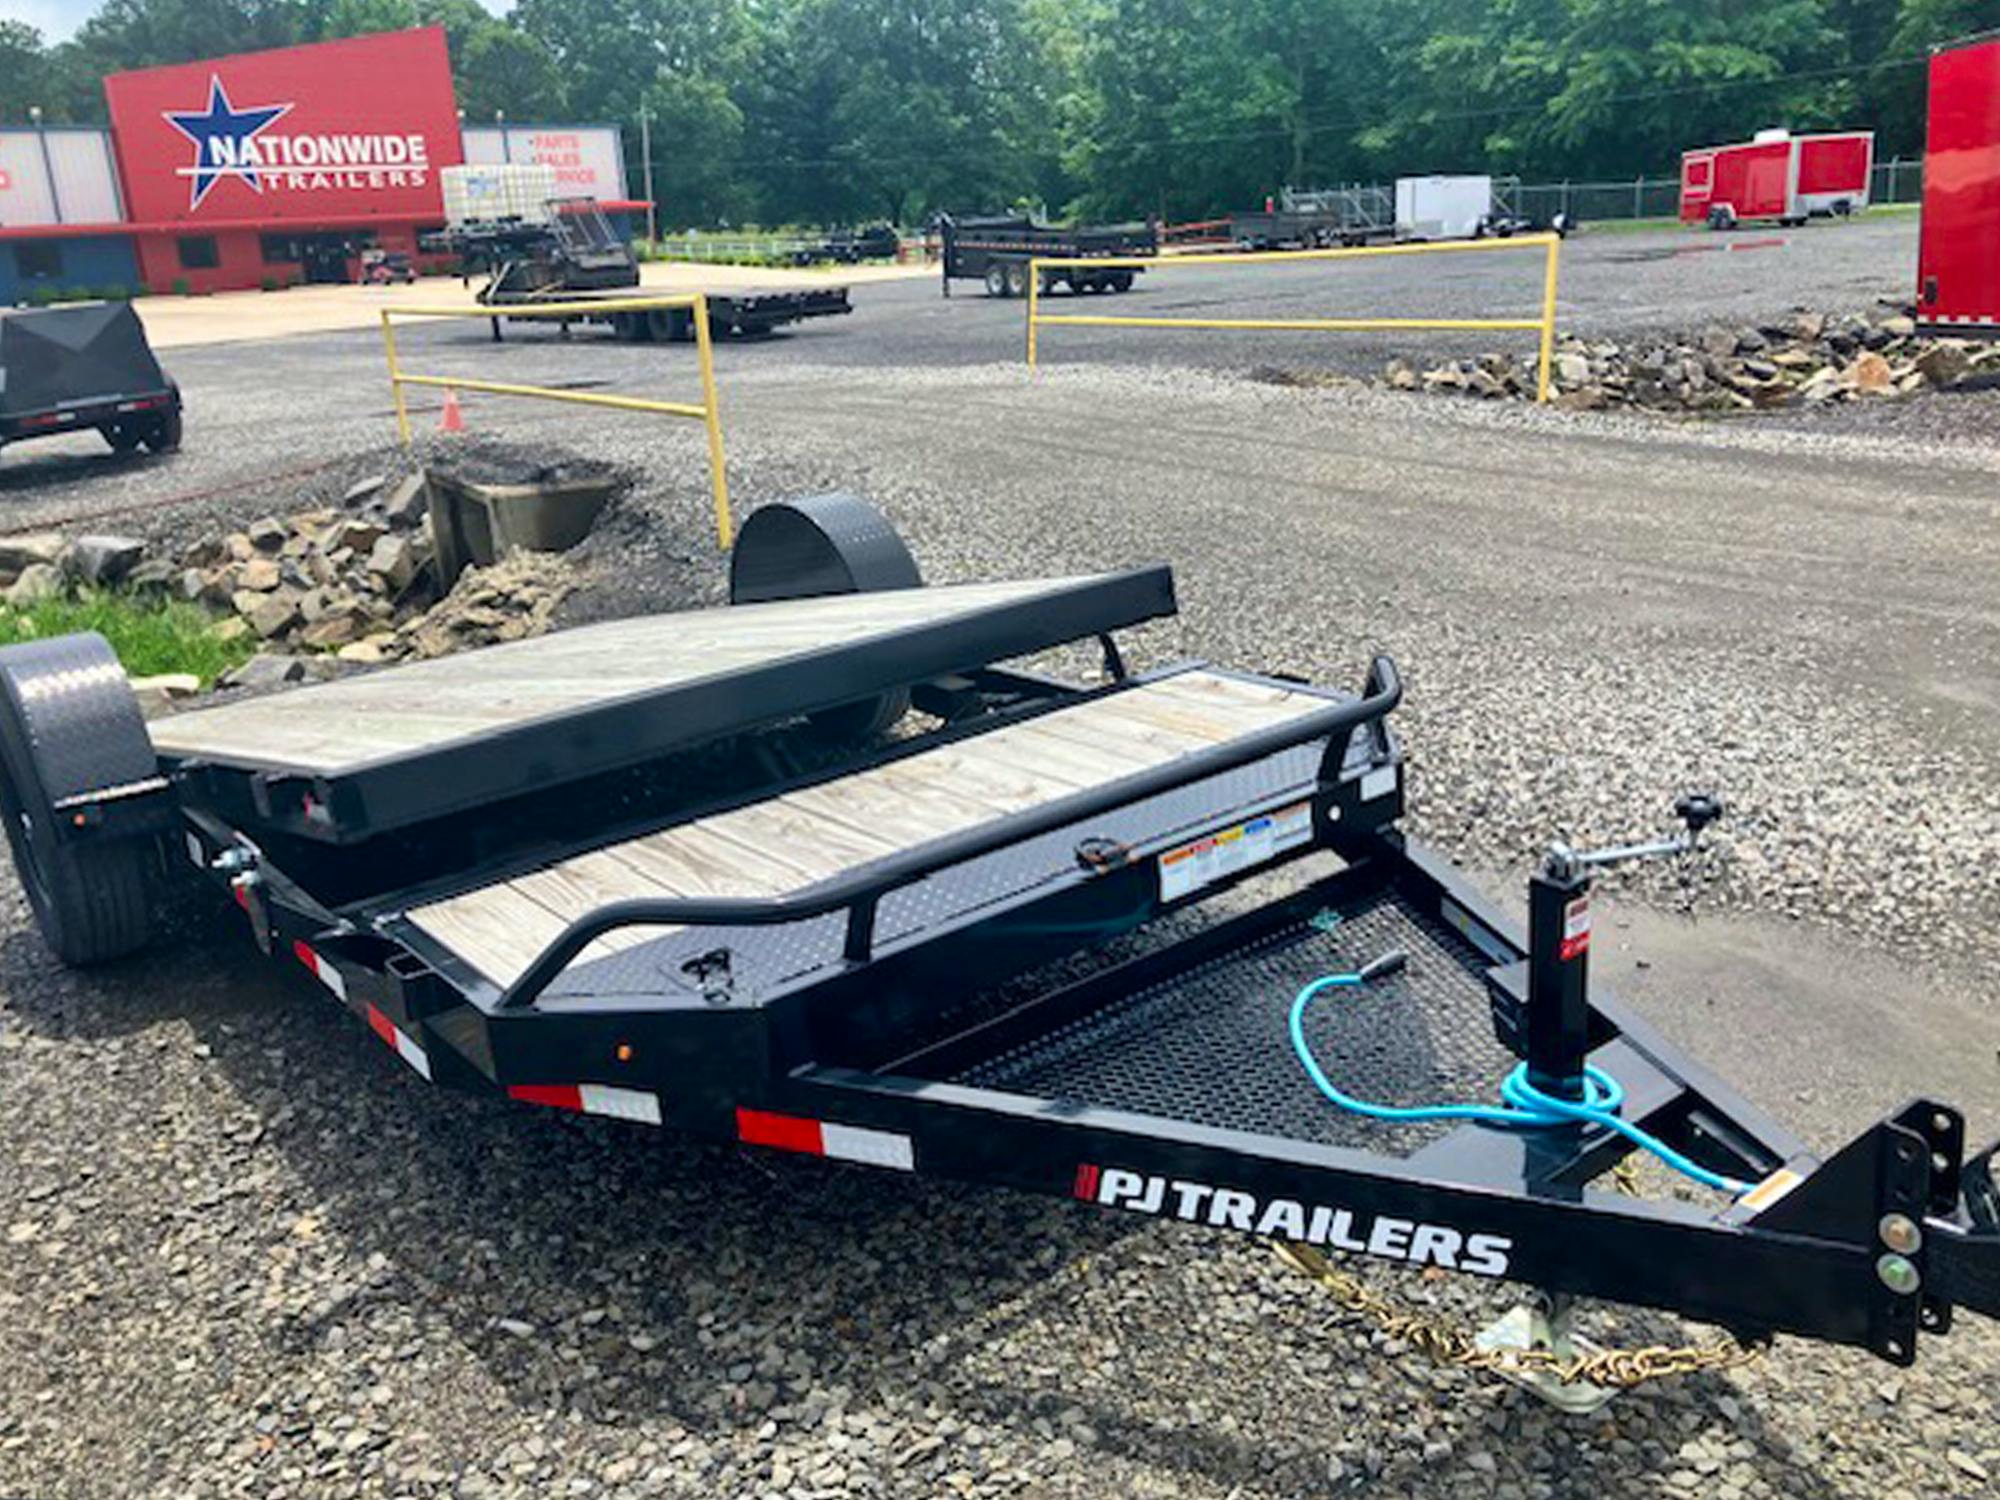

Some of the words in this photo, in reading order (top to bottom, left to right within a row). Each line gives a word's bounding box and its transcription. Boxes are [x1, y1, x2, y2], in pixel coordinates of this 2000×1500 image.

[208, 135, 428, 165] NATIONWIDE
[264, 171, 427, 189] TRAILERS
[1099, 1167, 1167, 1214] PJ
[1172, 1180, 1513, 1276] TRAILERS
